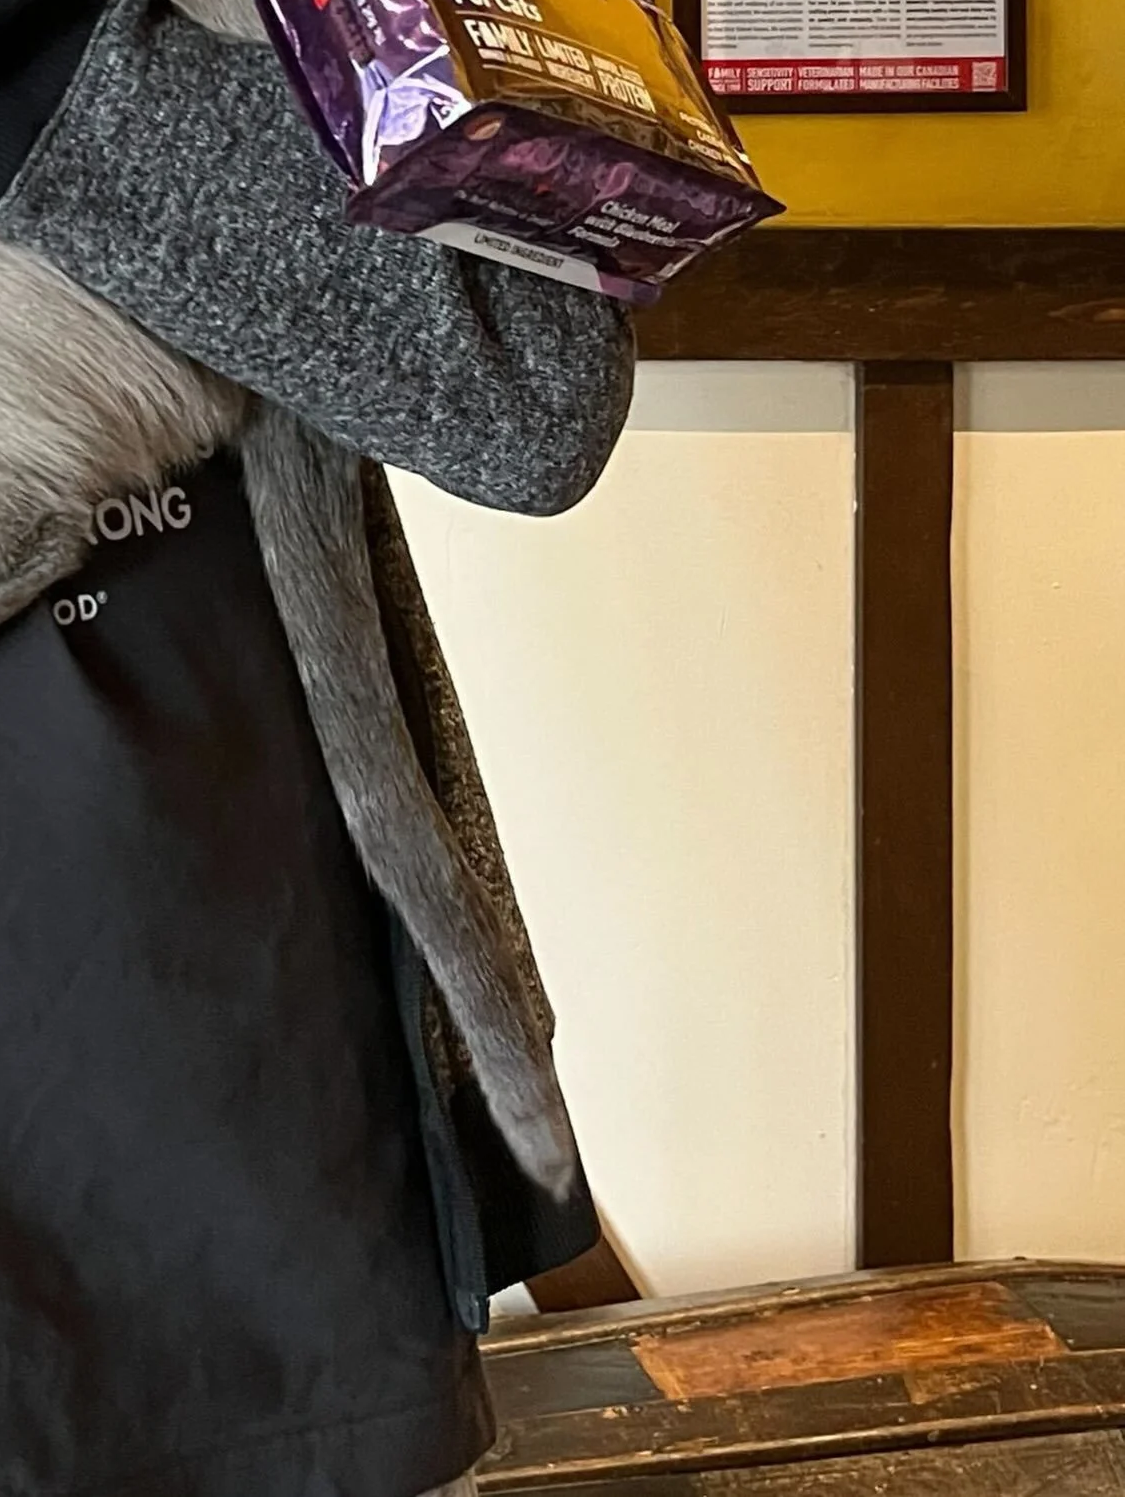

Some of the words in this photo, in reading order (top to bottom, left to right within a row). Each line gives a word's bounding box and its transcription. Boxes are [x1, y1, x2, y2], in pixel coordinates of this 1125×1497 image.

[463, 19, 535, 58] FAMILY
[534, 34, 592, 72] LIMITED
[596, 69, 656, 114] PROTEIN
[746, 79, 793, 91] SUPPORT
[600, 200, 651, 225] Chicken
[648, 215, 682, 233] Meal
